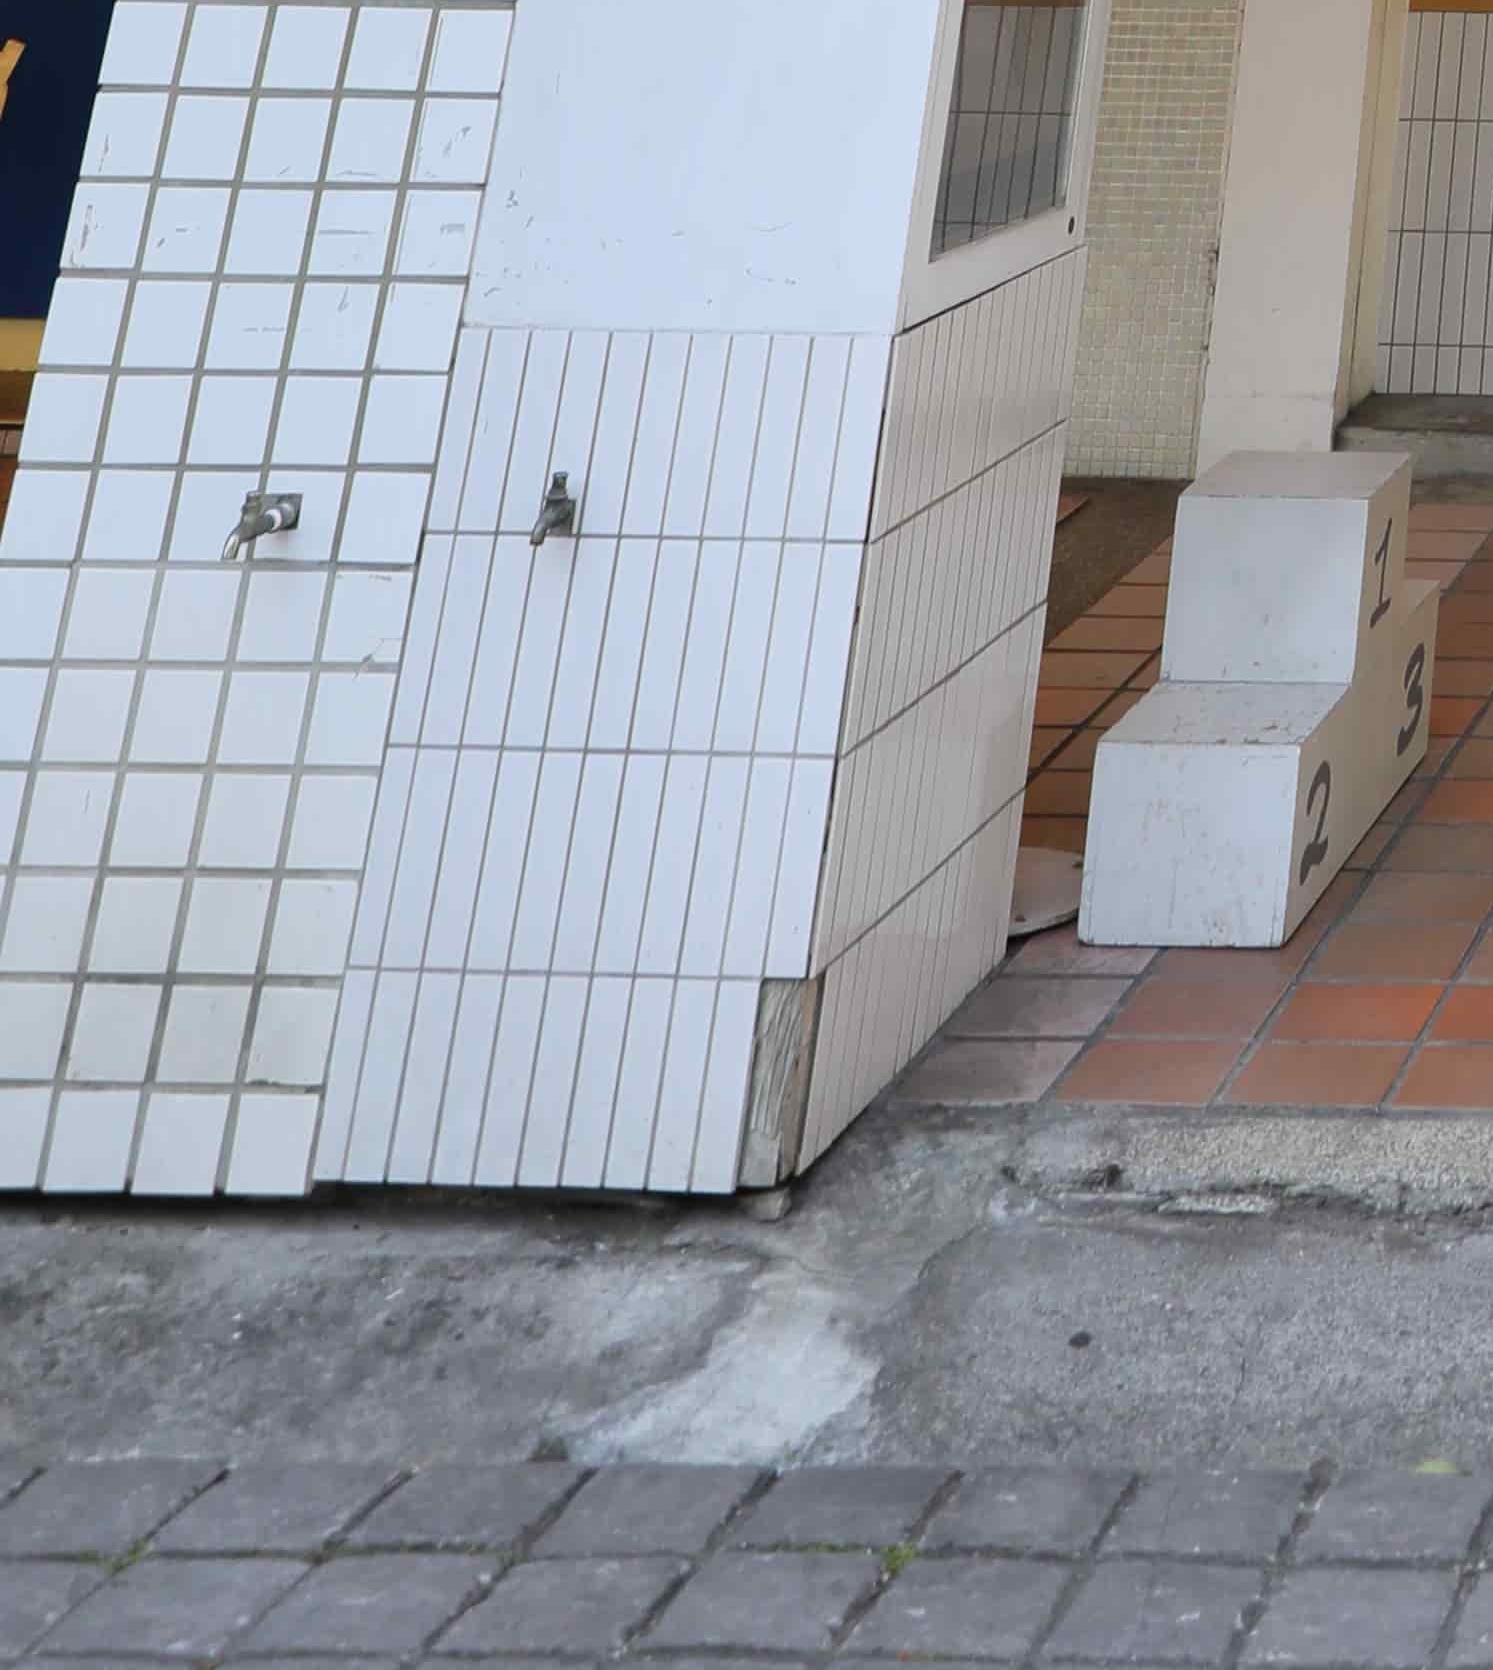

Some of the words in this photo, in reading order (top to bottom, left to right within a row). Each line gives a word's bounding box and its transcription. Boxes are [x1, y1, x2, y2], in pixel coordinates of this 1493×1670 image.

[1369, 516, 1394, 628] 1
[1396, 642, 1426, 758] 3
[1299, 759, 1332, 886] 2
